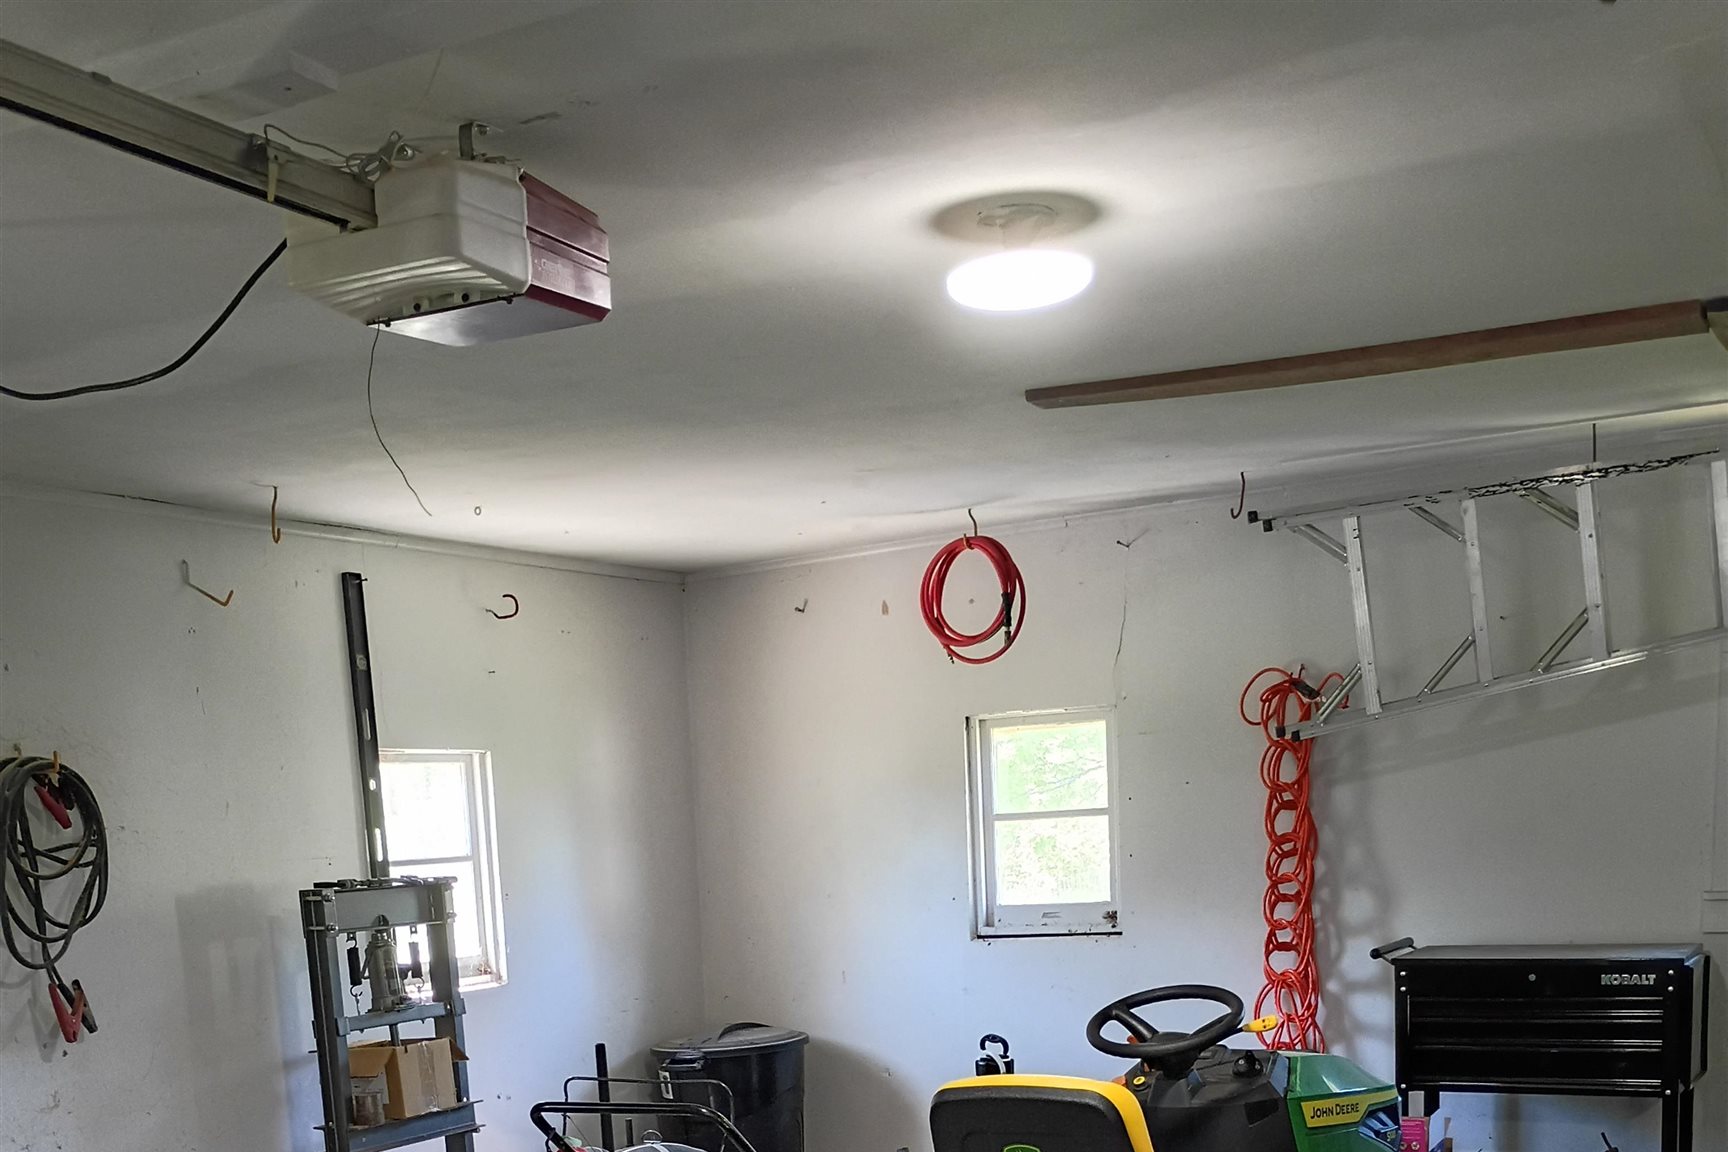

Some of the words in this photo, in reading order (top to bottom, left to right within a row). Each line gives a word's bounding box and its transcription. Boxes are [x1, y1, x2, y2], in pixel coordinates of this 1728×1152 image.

[1600, 974, 1656, 985] KOBALT
[1310, 1106, 1334, 1119] JOHN
[1335, 1102, 1360, 1115] DEERE
